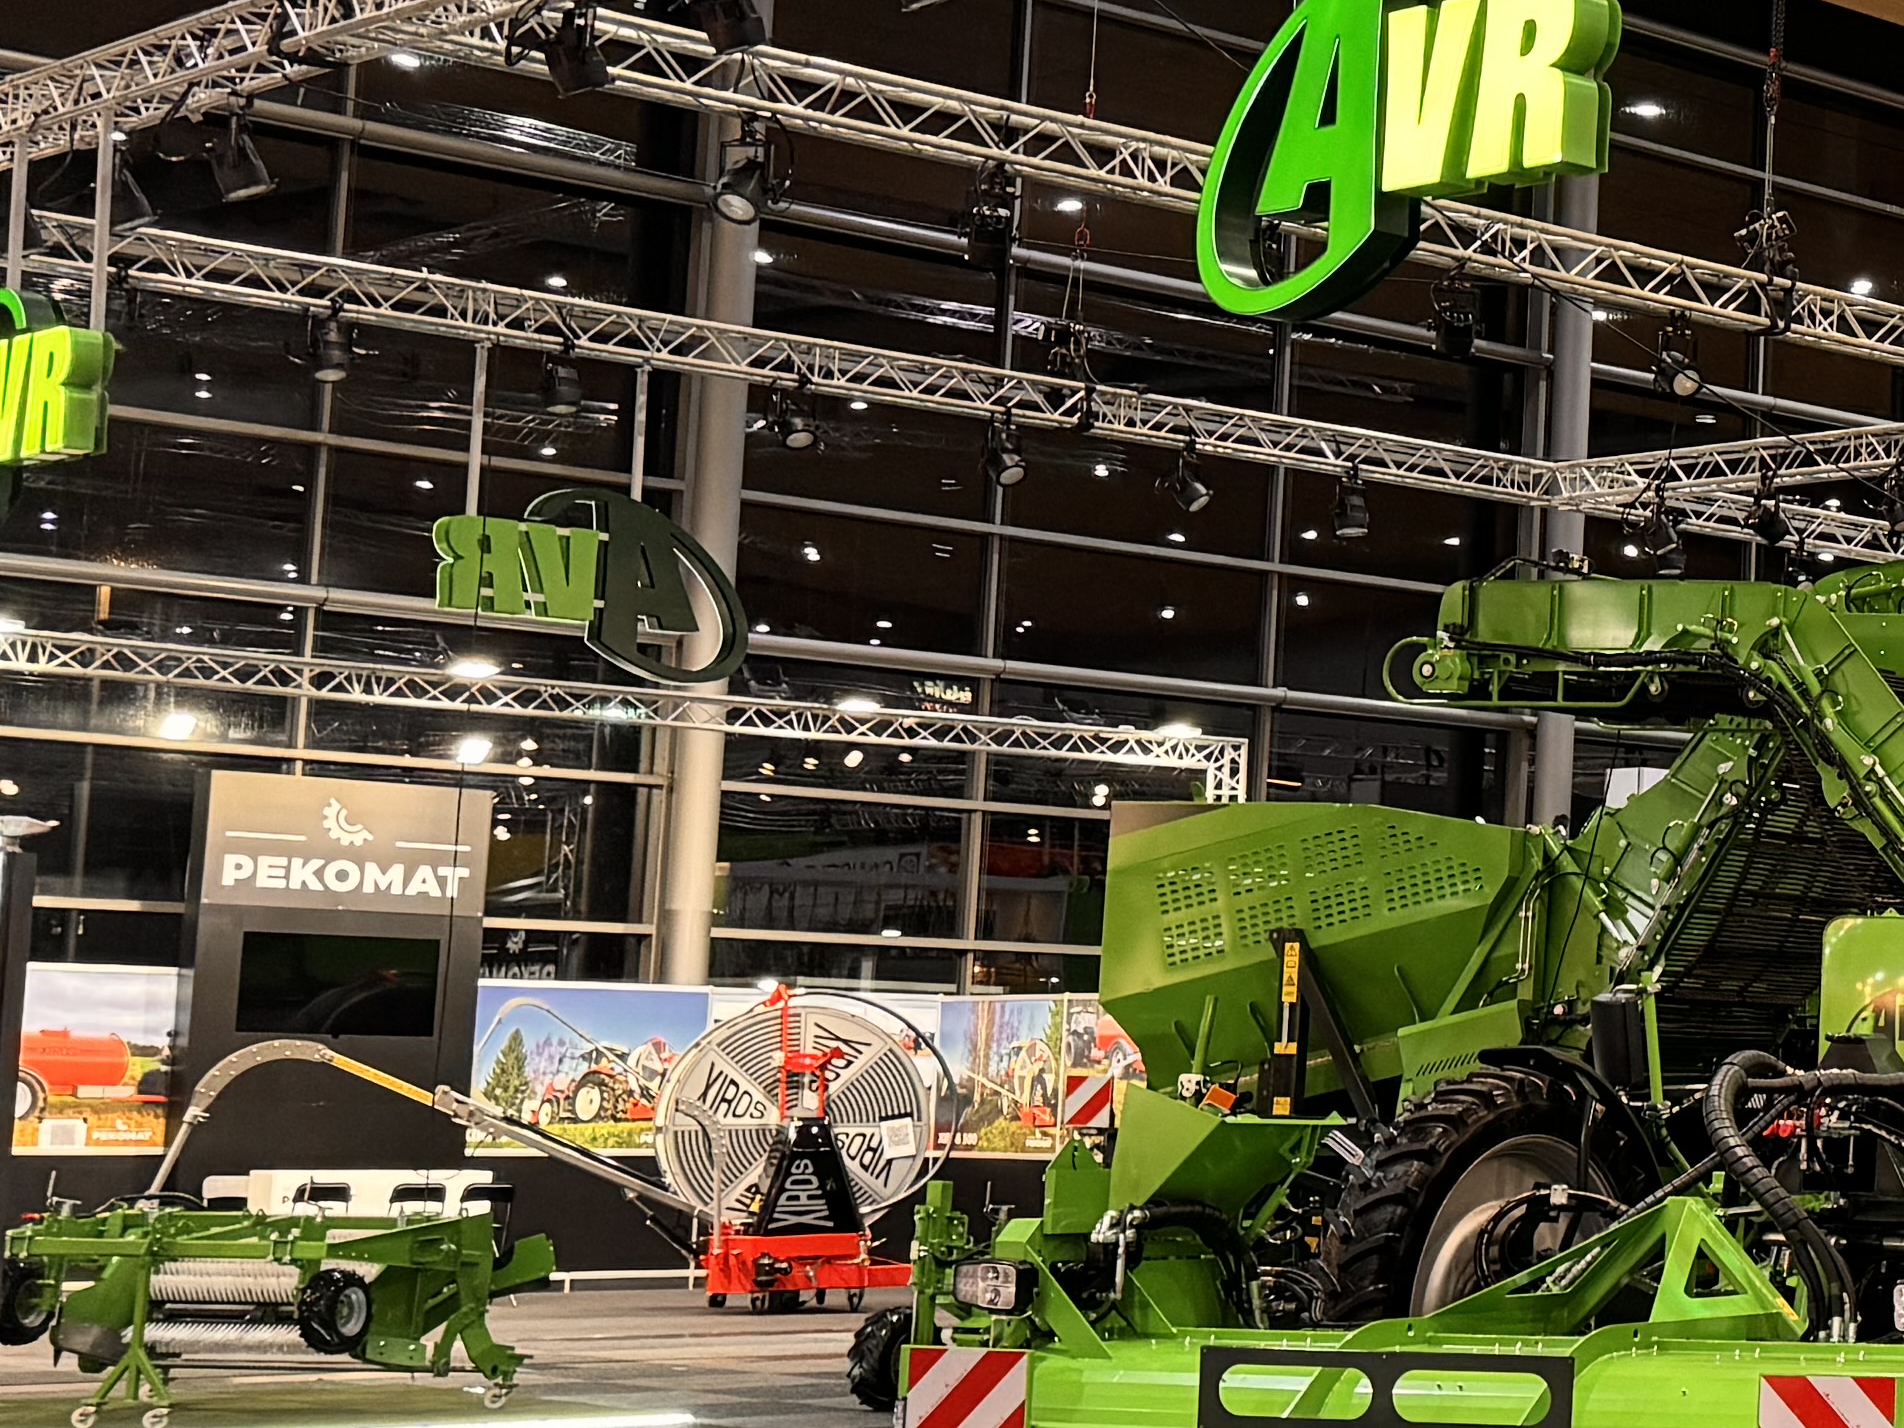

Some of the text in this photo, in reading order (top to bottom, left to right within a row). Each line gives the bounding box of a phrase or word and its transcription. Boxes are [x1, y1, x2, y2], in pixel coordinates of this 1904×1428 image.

[221, 853, 470, 898] PEKOMAT
[696, 1061, 768, 1121] XIROS
[767, 1158, 835, 1230] XIROS
